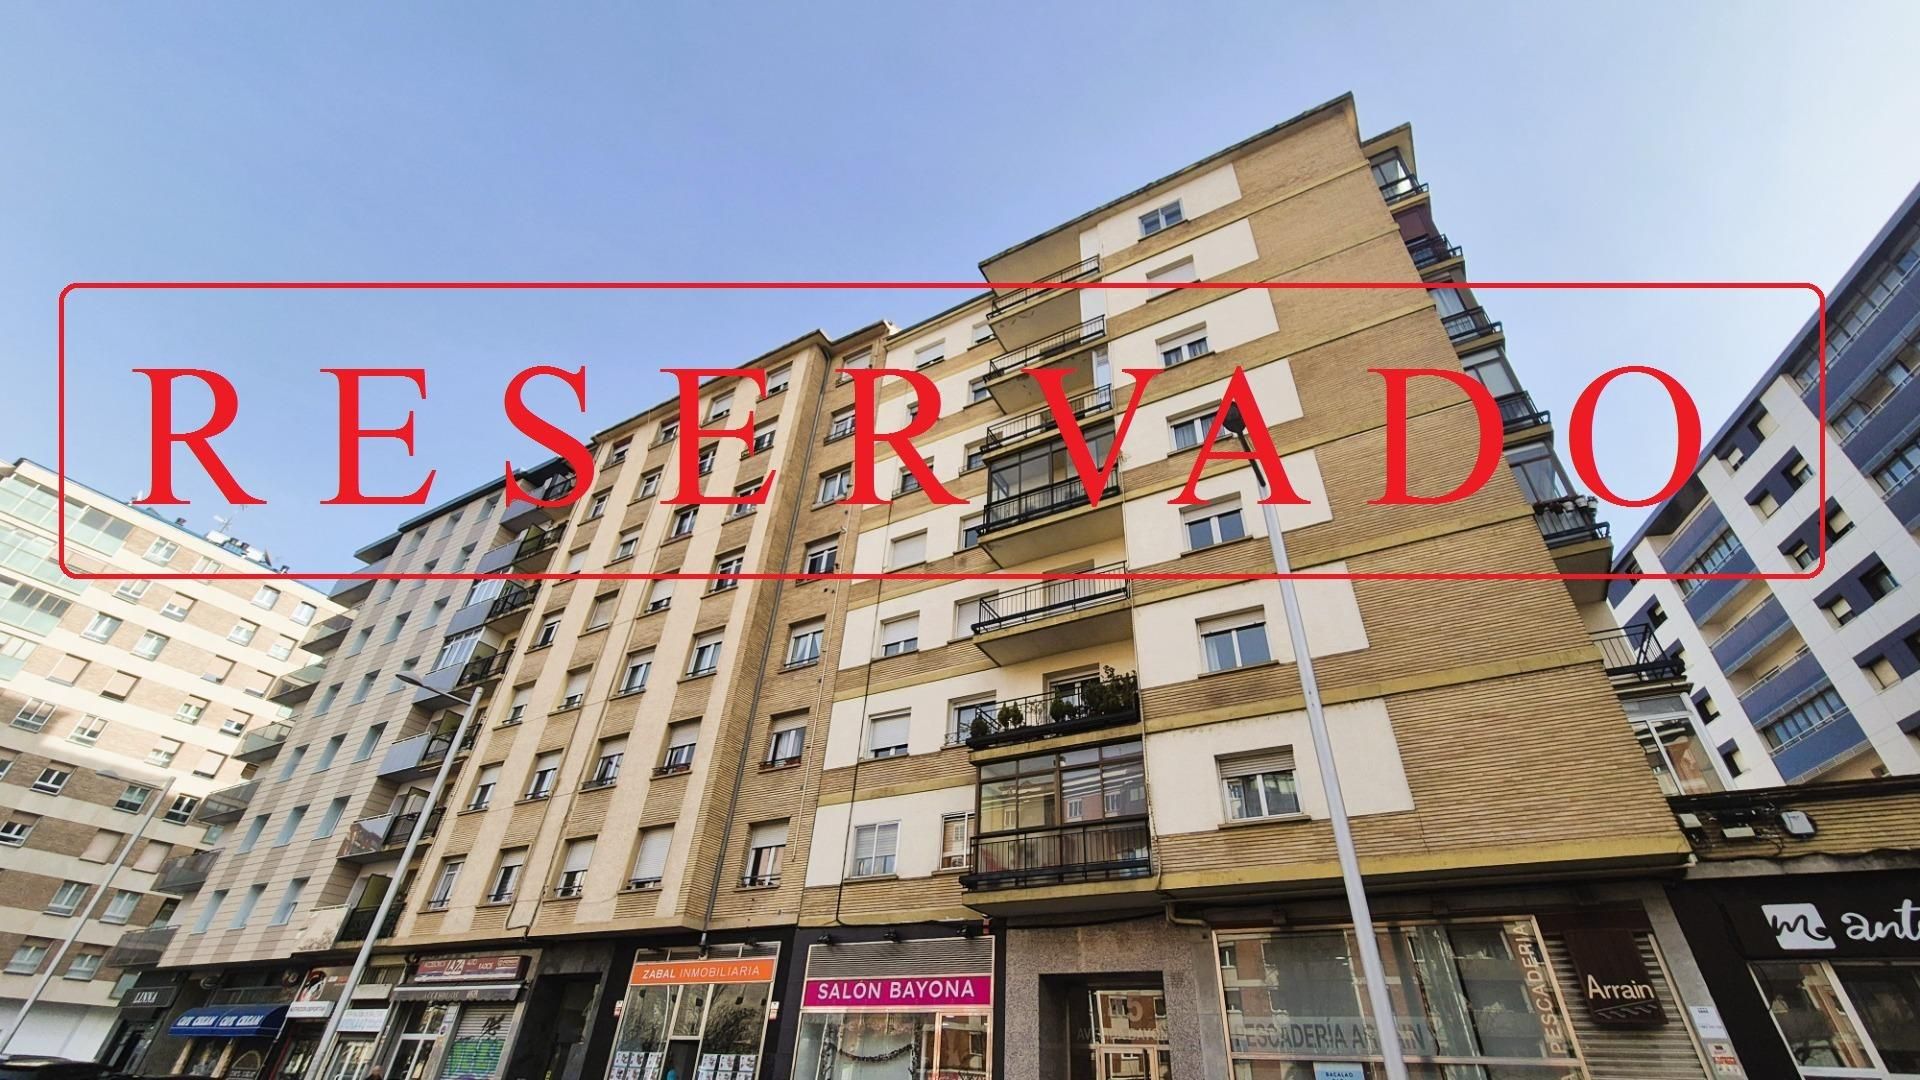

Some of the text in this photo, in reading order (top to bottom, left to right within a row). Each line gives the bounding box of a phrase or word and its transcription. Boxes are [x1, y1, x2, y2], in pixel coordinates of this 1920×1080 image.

[1841, 898, 1920, 943] ant
[642, 965, 760, 980] ZABAL INMOBILIARIA
[889, 979, 975, 999] BAYONA
[1587, 974, 1655, 999] Arrain
